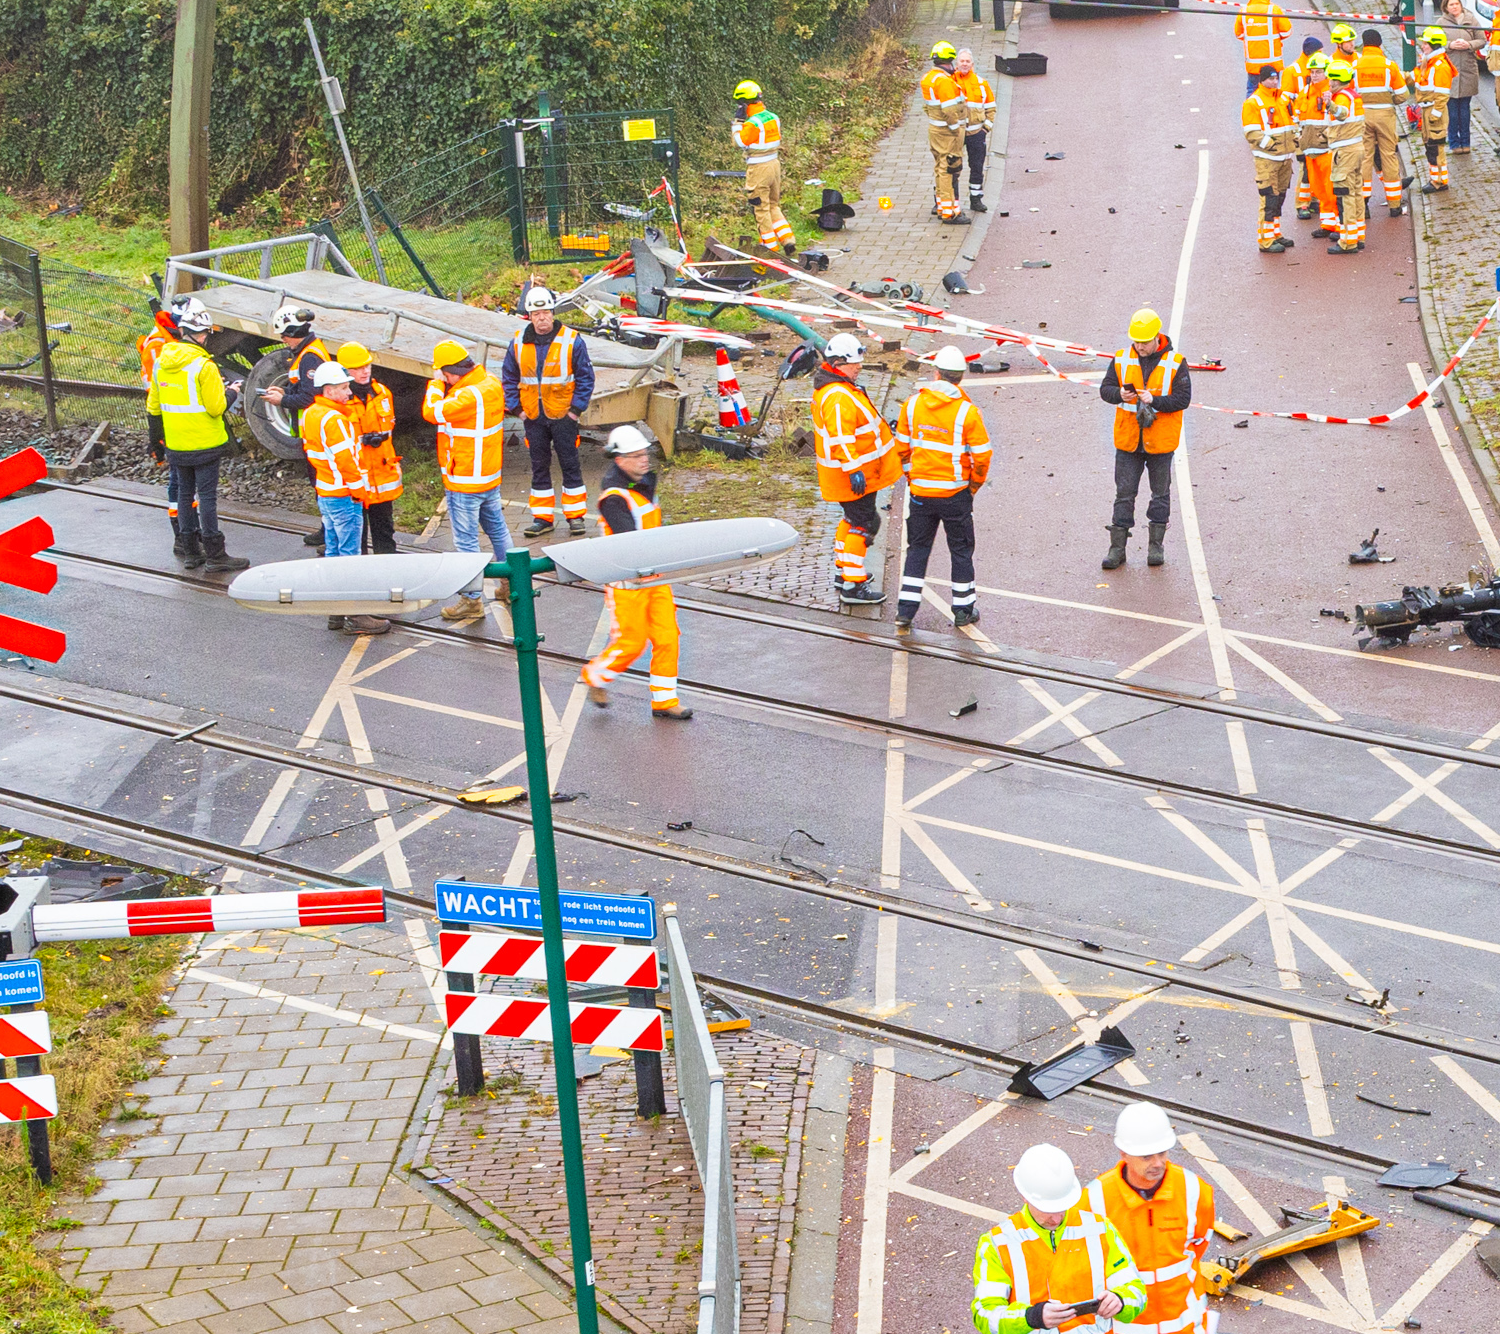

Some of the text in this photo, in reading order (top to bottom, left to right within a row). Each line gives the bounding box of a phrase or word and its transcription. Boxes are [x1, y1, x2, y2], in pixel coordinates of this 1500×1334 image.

[442, 891, 531, 919] WACHT
[563, 901, 581, 910] rode
[583, 902, 602, 911] licht
[603, 904, 636, 915] gedoofd
[638, 907, 646, 915] is
[562, 916, 577, 926] nog
[579, 917, 594, 925] een
[596, 917, 616, 927] trein
[618, 918, 646, 930] komen
[27, 969, 37, 979] is
[4, 983, 39, 997] komen
